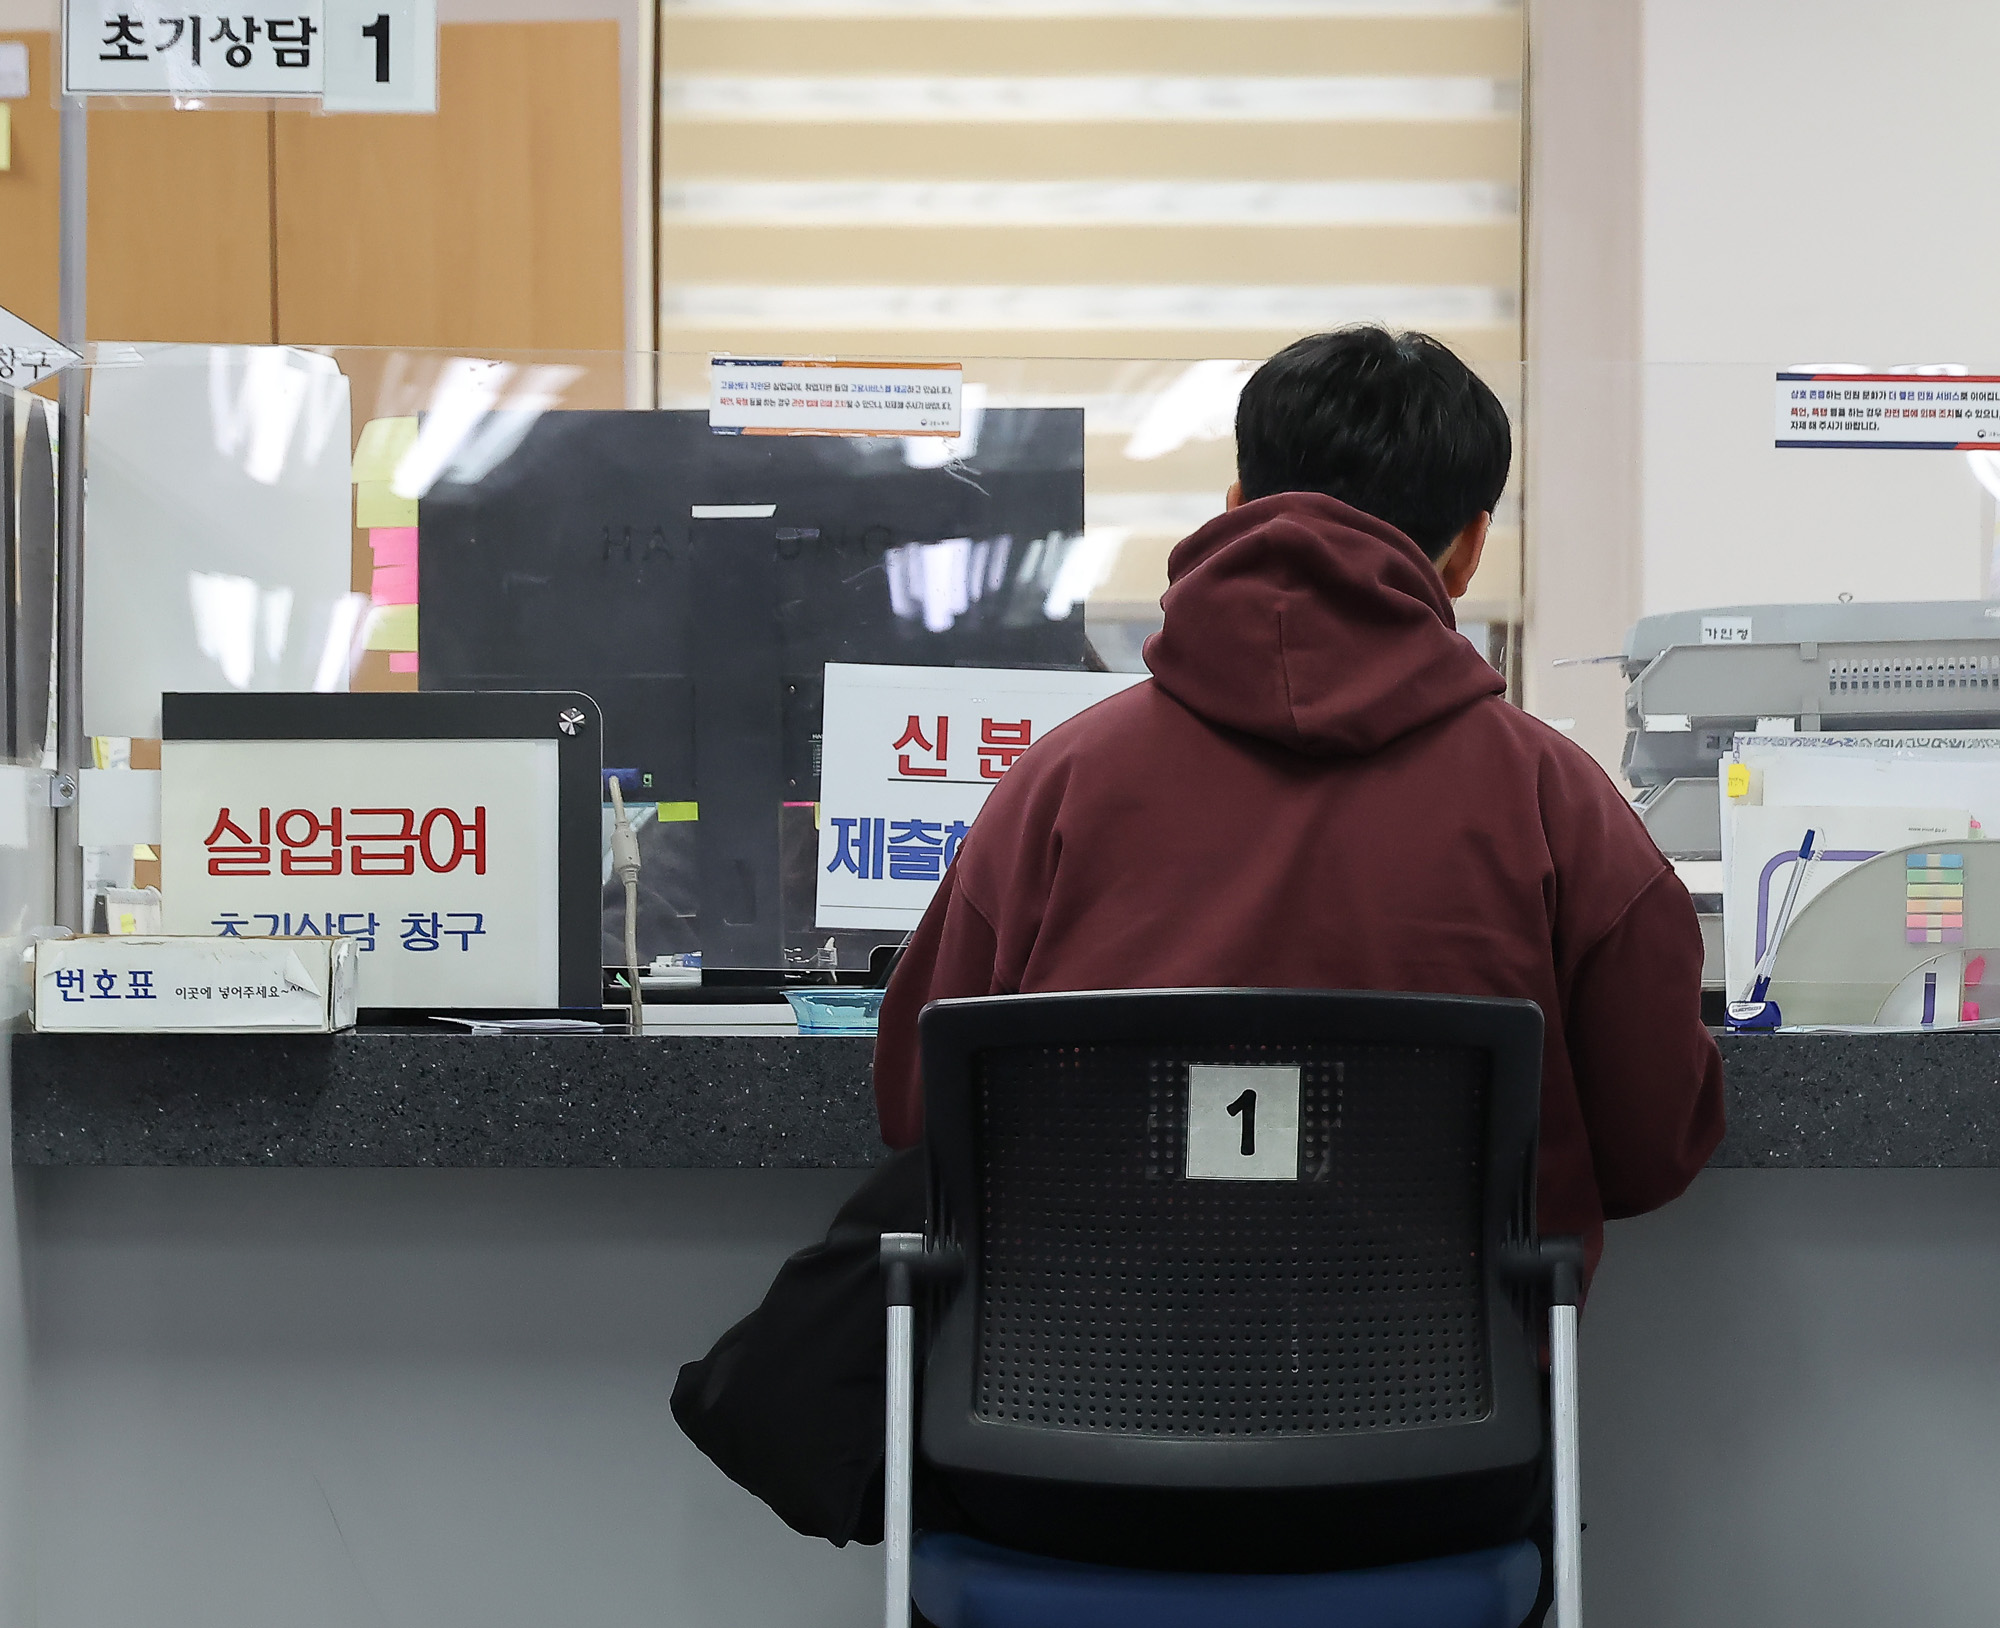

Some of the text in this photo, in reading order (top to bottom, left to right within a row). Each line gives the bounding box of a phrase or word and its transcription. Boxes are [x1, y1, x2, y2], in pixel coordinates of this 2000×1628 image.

[99, 13, 391, 84] 초기상담 1
[1790, 390, 1807, 400] 상호
[1888, 391, 1897, 401] 더
[1818, 421, 1843, 431] 주시기
[1844, 421, 1880, 431] 바랍니다.
[203, 806, 487, 876] 실업급여
[399, 911, 487, 952] 창구
[55, 968, 158, 1003] 번호표
[175, 986, 212, 1000] 이곳에
[1226, 1089, 1257, 1157] 1
